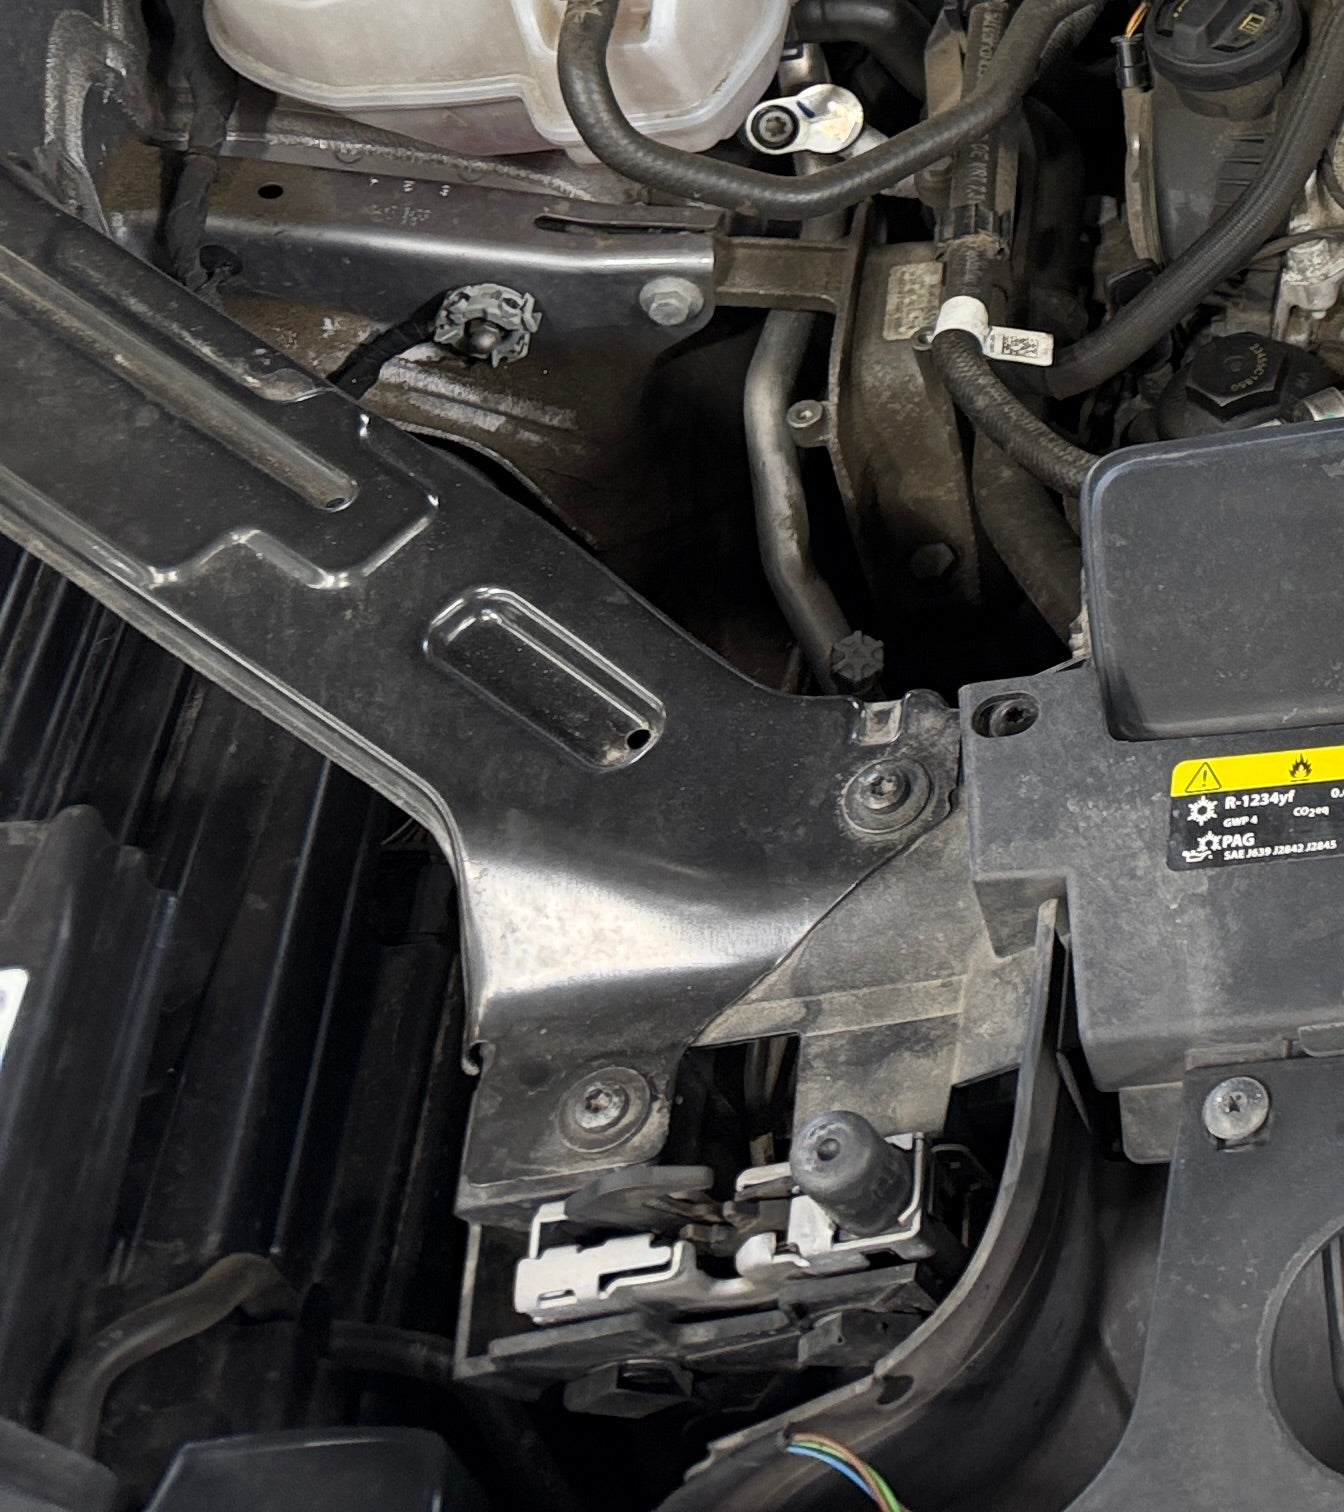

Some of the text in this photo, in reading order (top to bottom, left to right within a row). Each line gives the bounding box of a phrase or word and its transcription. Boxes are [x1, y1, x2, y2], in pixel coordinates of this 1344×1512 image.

[1225, 790, 1296, 809] R-1234yf
[1223, 815, 1258, 828] GWP 4
[1221, 833, 1255, 848] PAG
[1224, 840, 1337, 860] SAE J639 J2842 J2845
